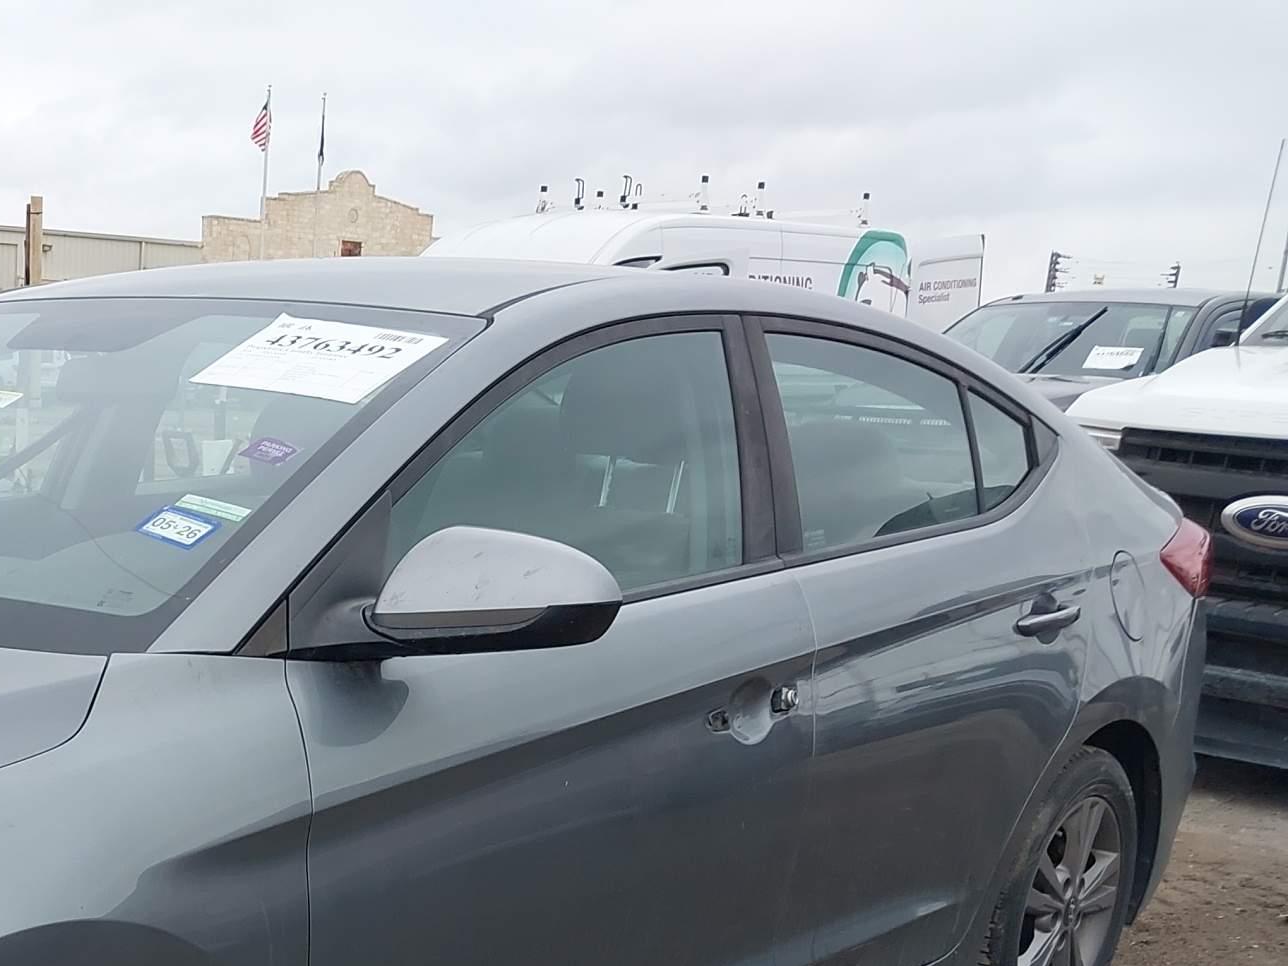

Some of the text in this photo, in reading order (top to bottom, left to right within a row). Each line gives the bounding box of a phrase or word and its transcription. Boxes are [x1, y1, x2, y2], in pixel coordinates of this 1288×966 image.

[918, 278, 977, 292] AIR CONDITIONING
[918, 292, 950, 304] Specialist
[265, 333, 403, 360] 43763492
[1251, 509, 1288, 533] For
